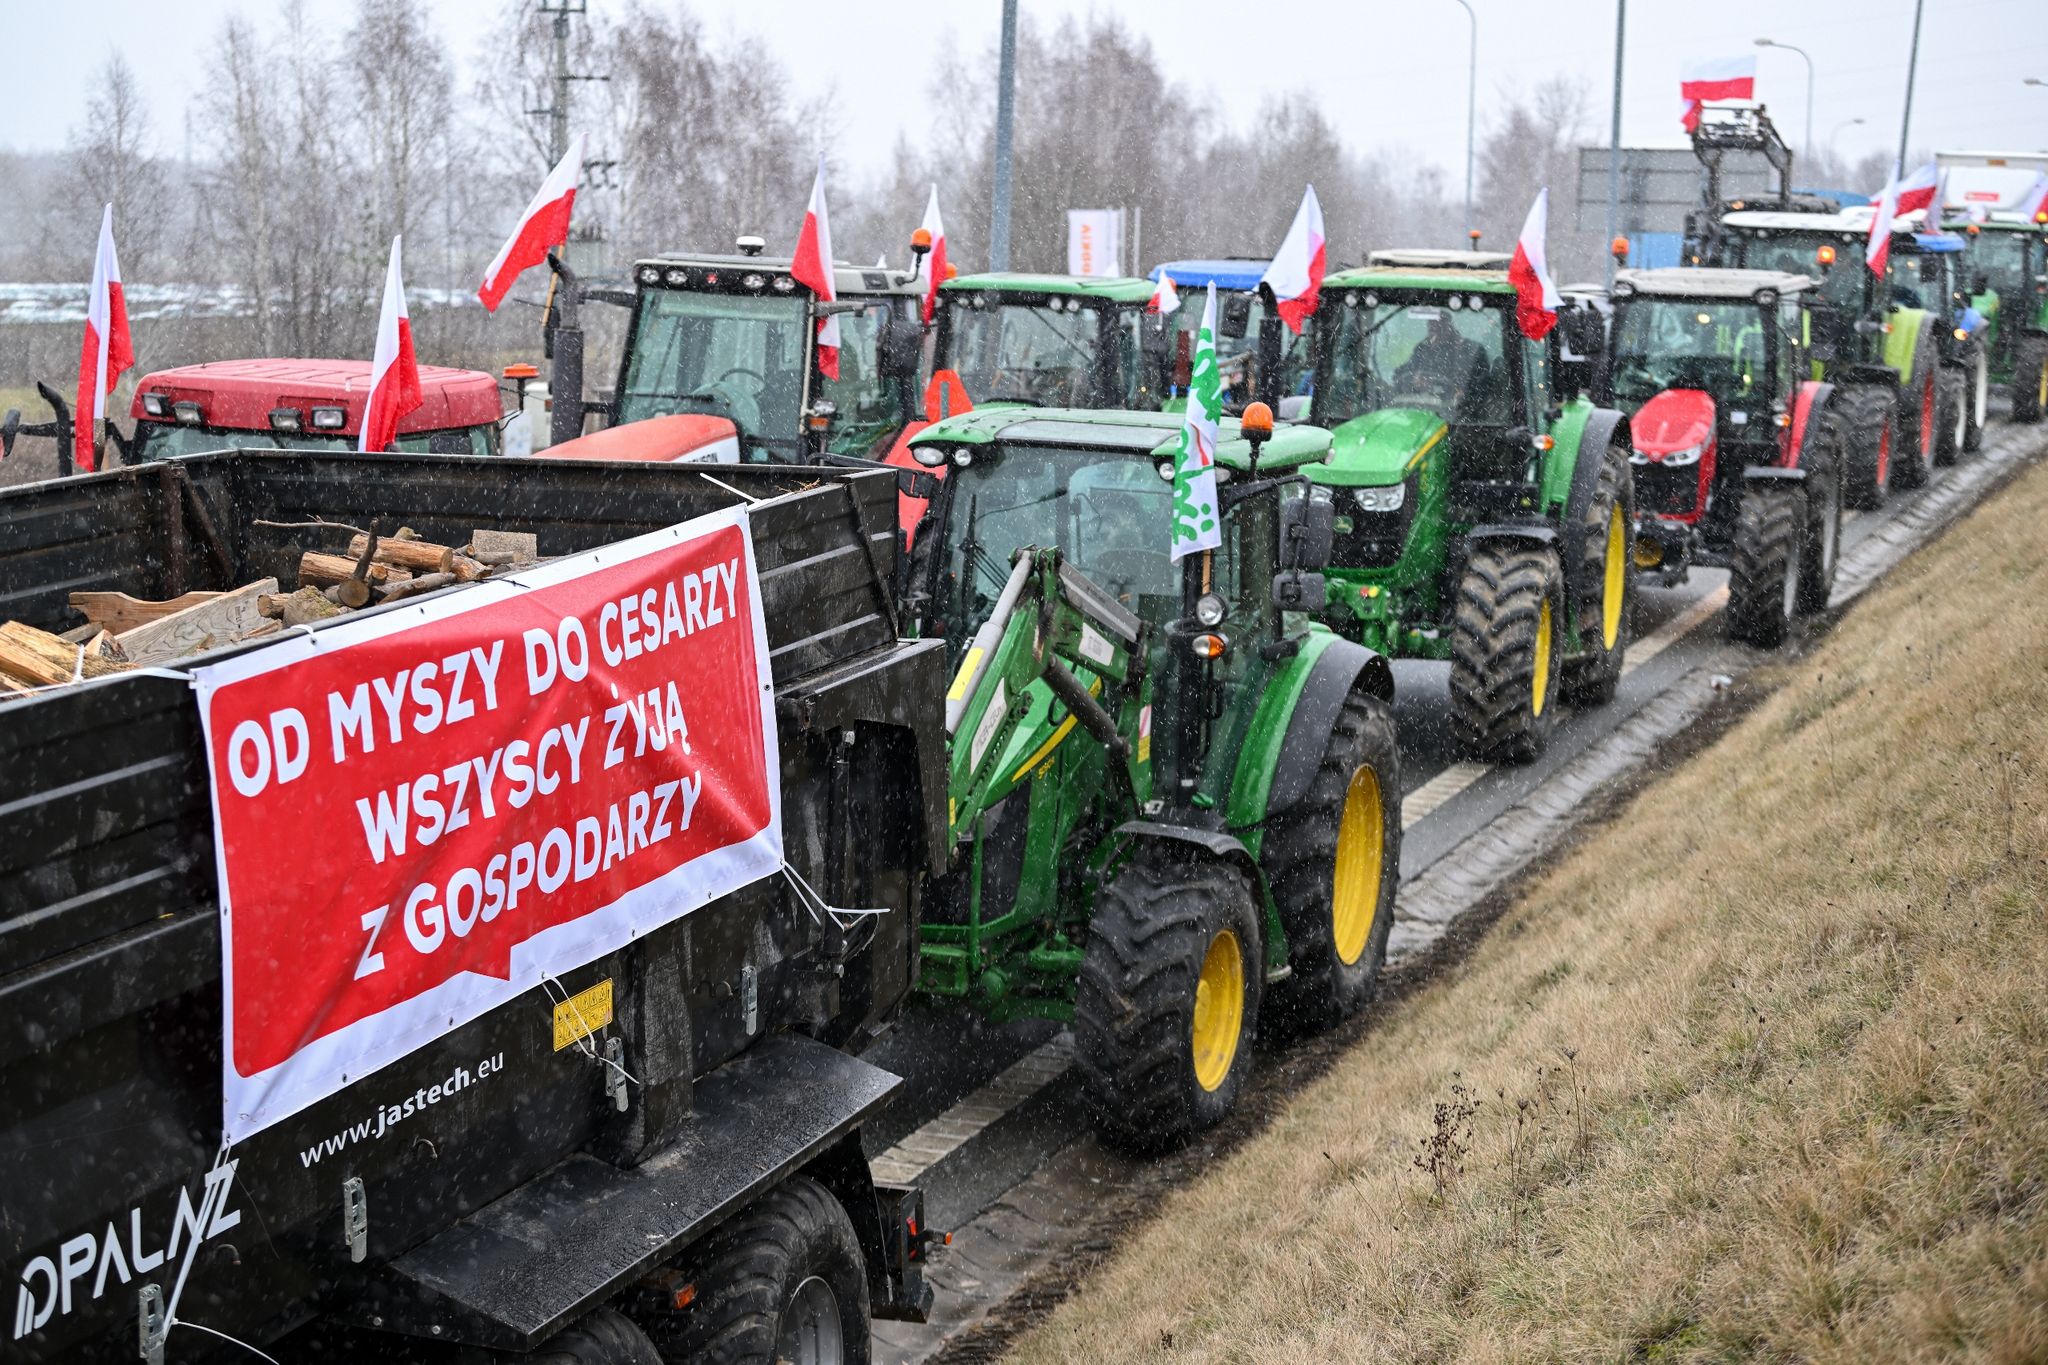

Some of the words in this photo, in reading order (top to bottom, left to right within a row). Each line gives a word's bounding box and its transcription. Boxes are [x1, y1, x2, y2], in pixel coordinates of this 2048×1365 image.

[228, 707, 310, 798] OD
[327, 639, 505, 764] MYSZY
[522, 614, 589, 696] DO
[599, 557, 739, 668] CESARZY
[355, 715, 590, 865] WSZYSCY
[603, 681, 692, 770] ŻYJĄ
[354, 904, 390, 981] Z
[403, 769, 702, 954] GOSPODARZY
[300, 1051, 504, 1168] www.jastech.eu
